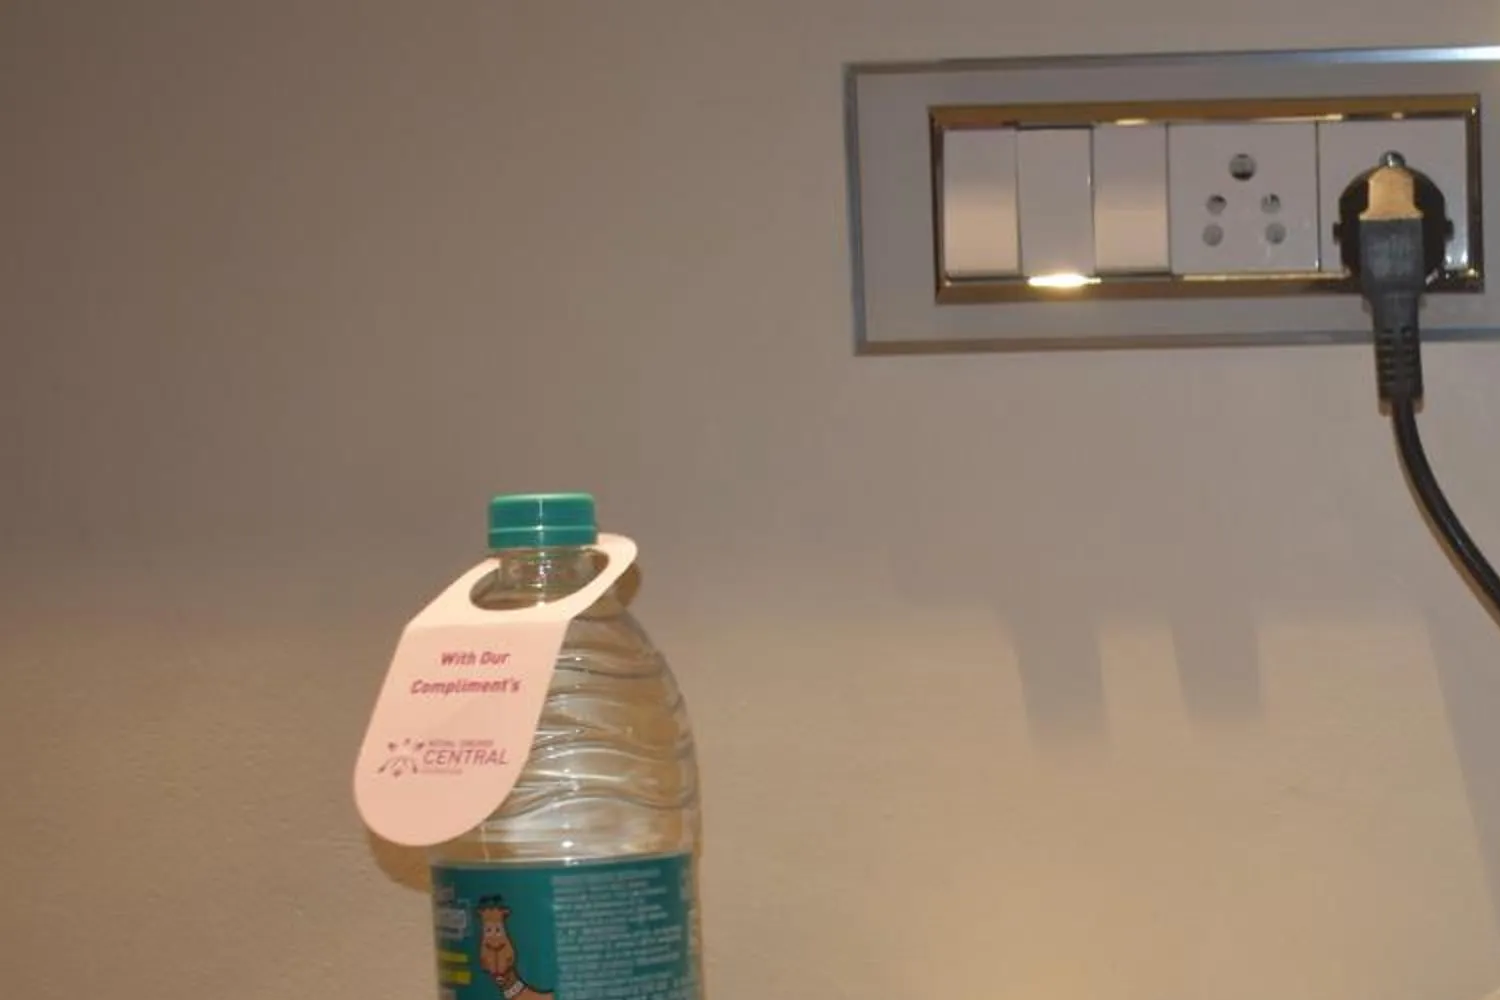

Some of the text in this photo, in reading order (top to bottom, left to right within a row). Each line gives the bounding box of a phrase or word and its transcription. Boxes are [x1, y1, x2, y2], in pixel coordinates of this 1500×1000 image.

[441, 651, 511, 666] With Our
[409, 679, 521, 695] Compliment's
[423, 748, 508, 766] CENTRAL
